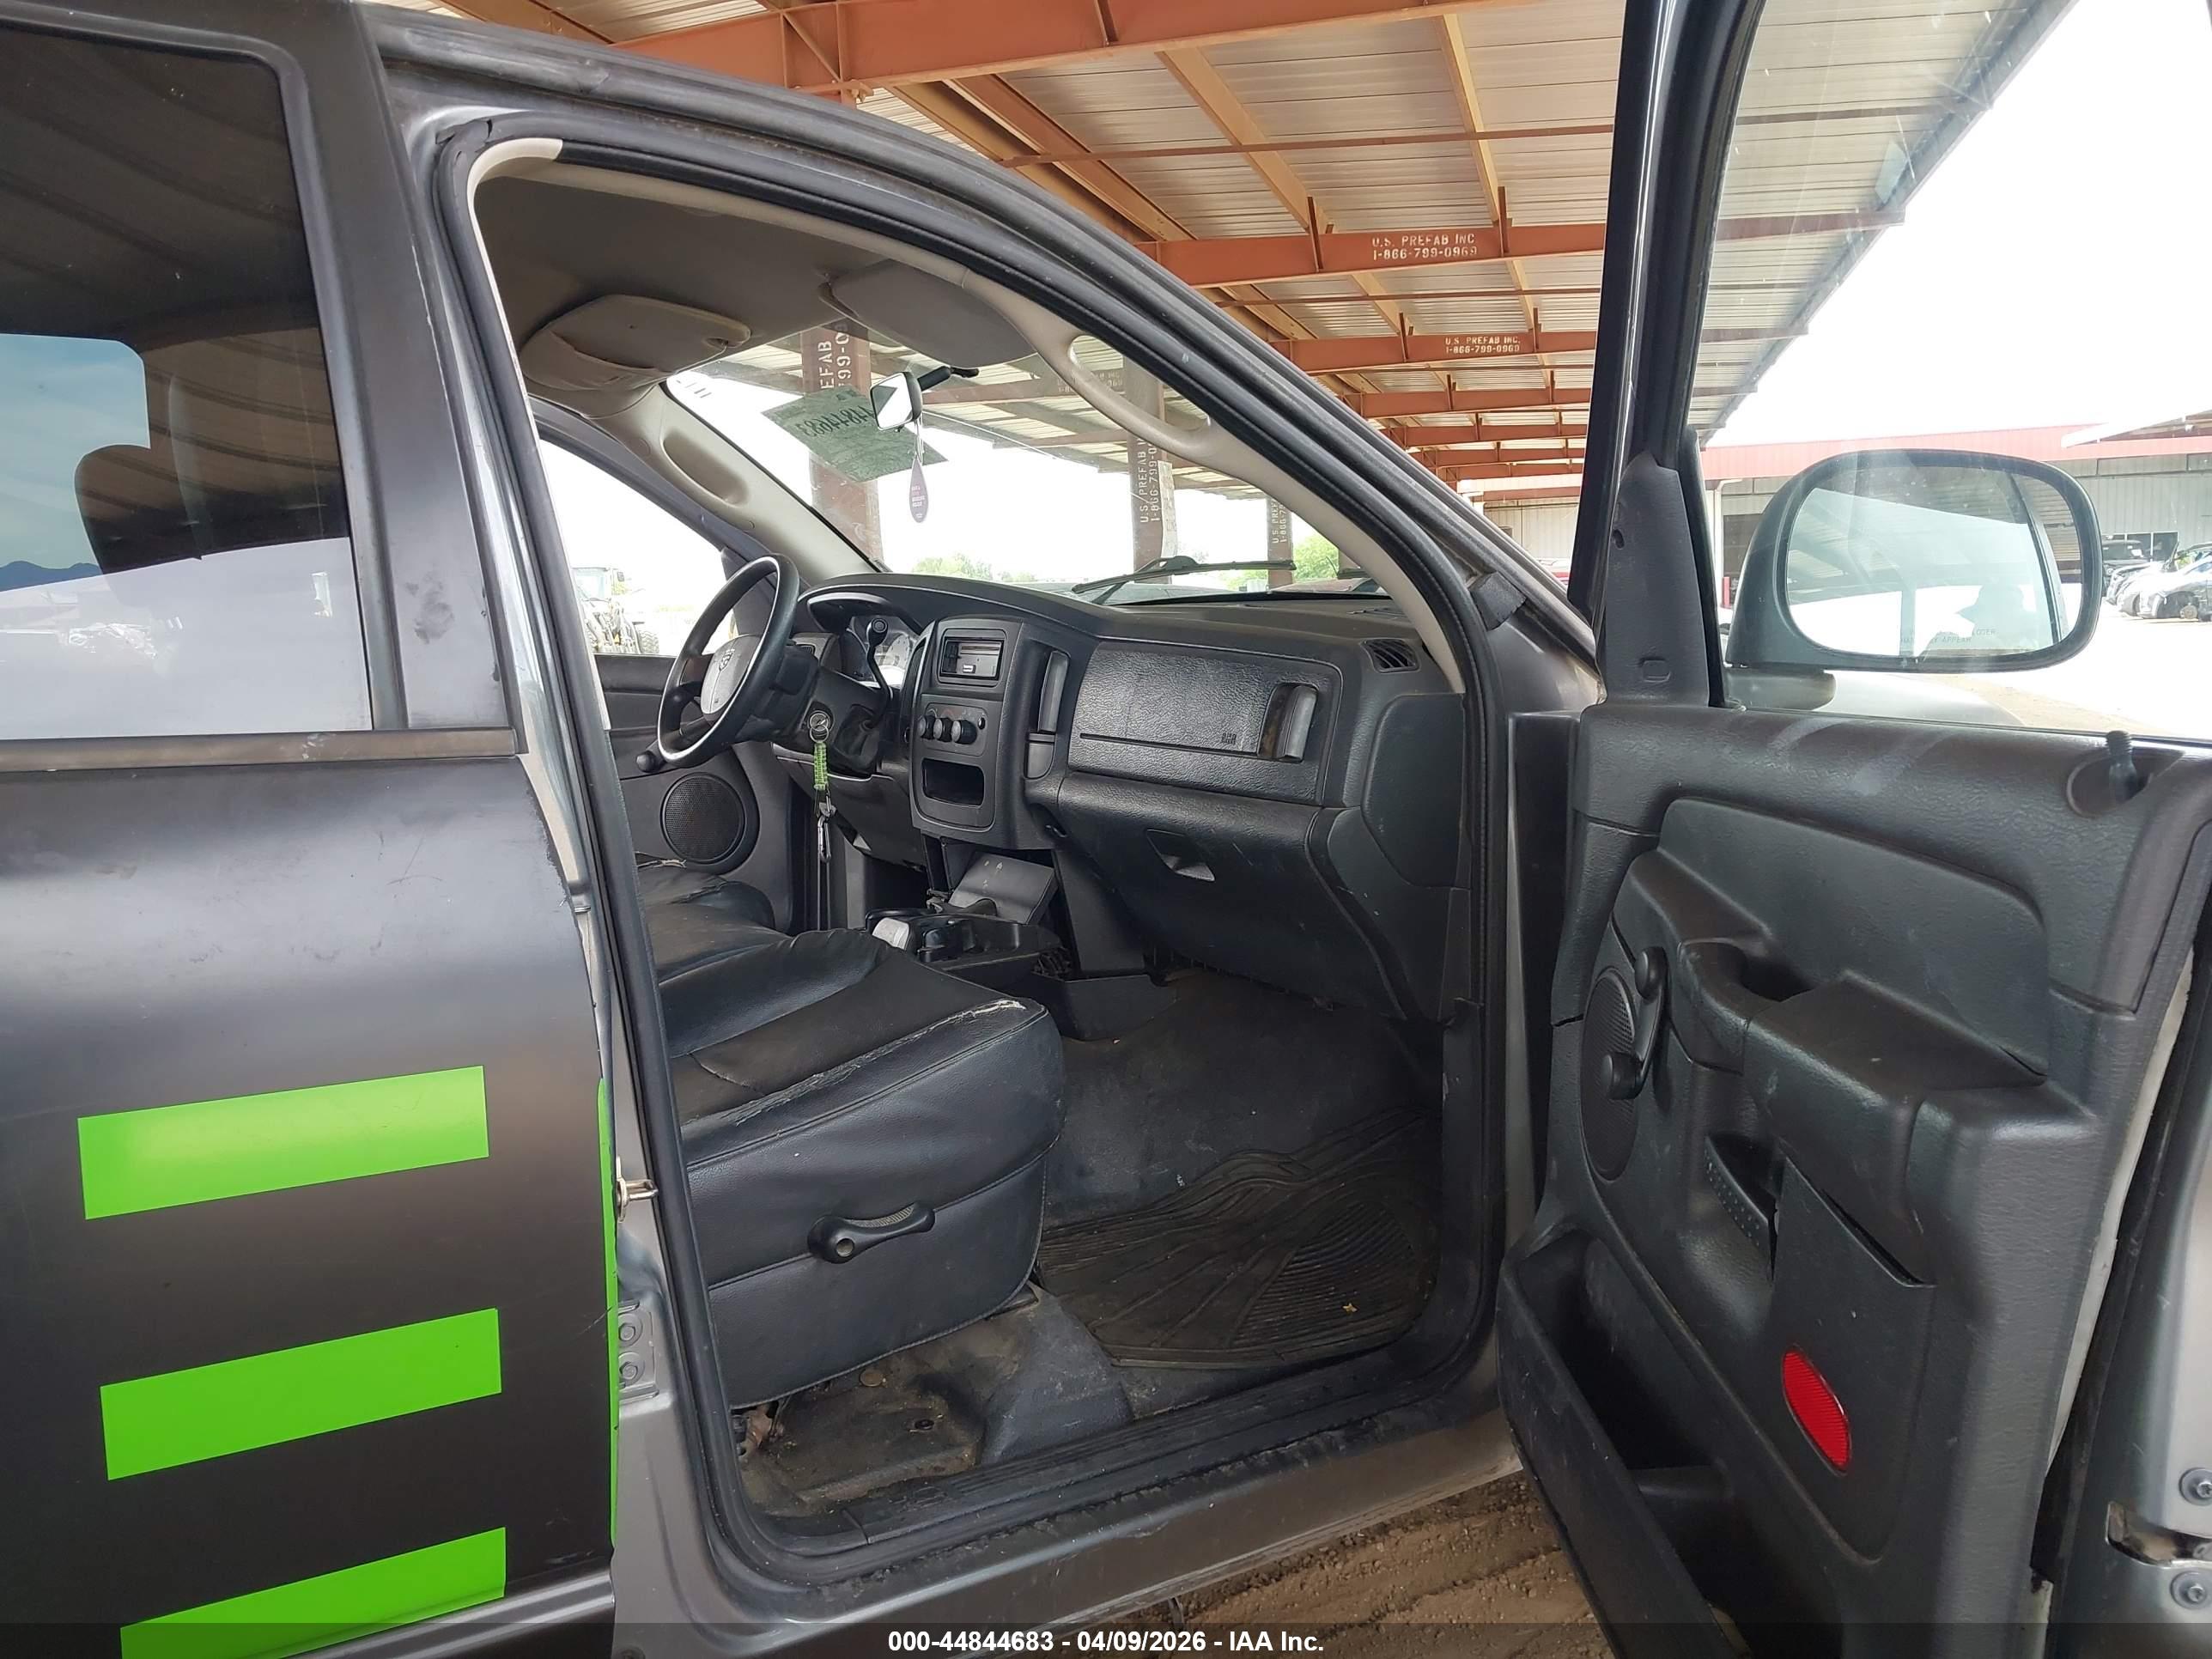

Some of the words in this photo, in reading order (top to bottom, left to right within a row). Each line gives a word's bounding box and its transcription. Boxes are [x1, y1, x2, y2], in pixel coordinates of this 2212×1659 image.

[1401, 234, 1449, 246] PREFAB
[1466, 336, 1500, 344] PREFAB
[817, 340, 835, 389] EFAB
[1137, 451, 1148, 495] PREFAB
